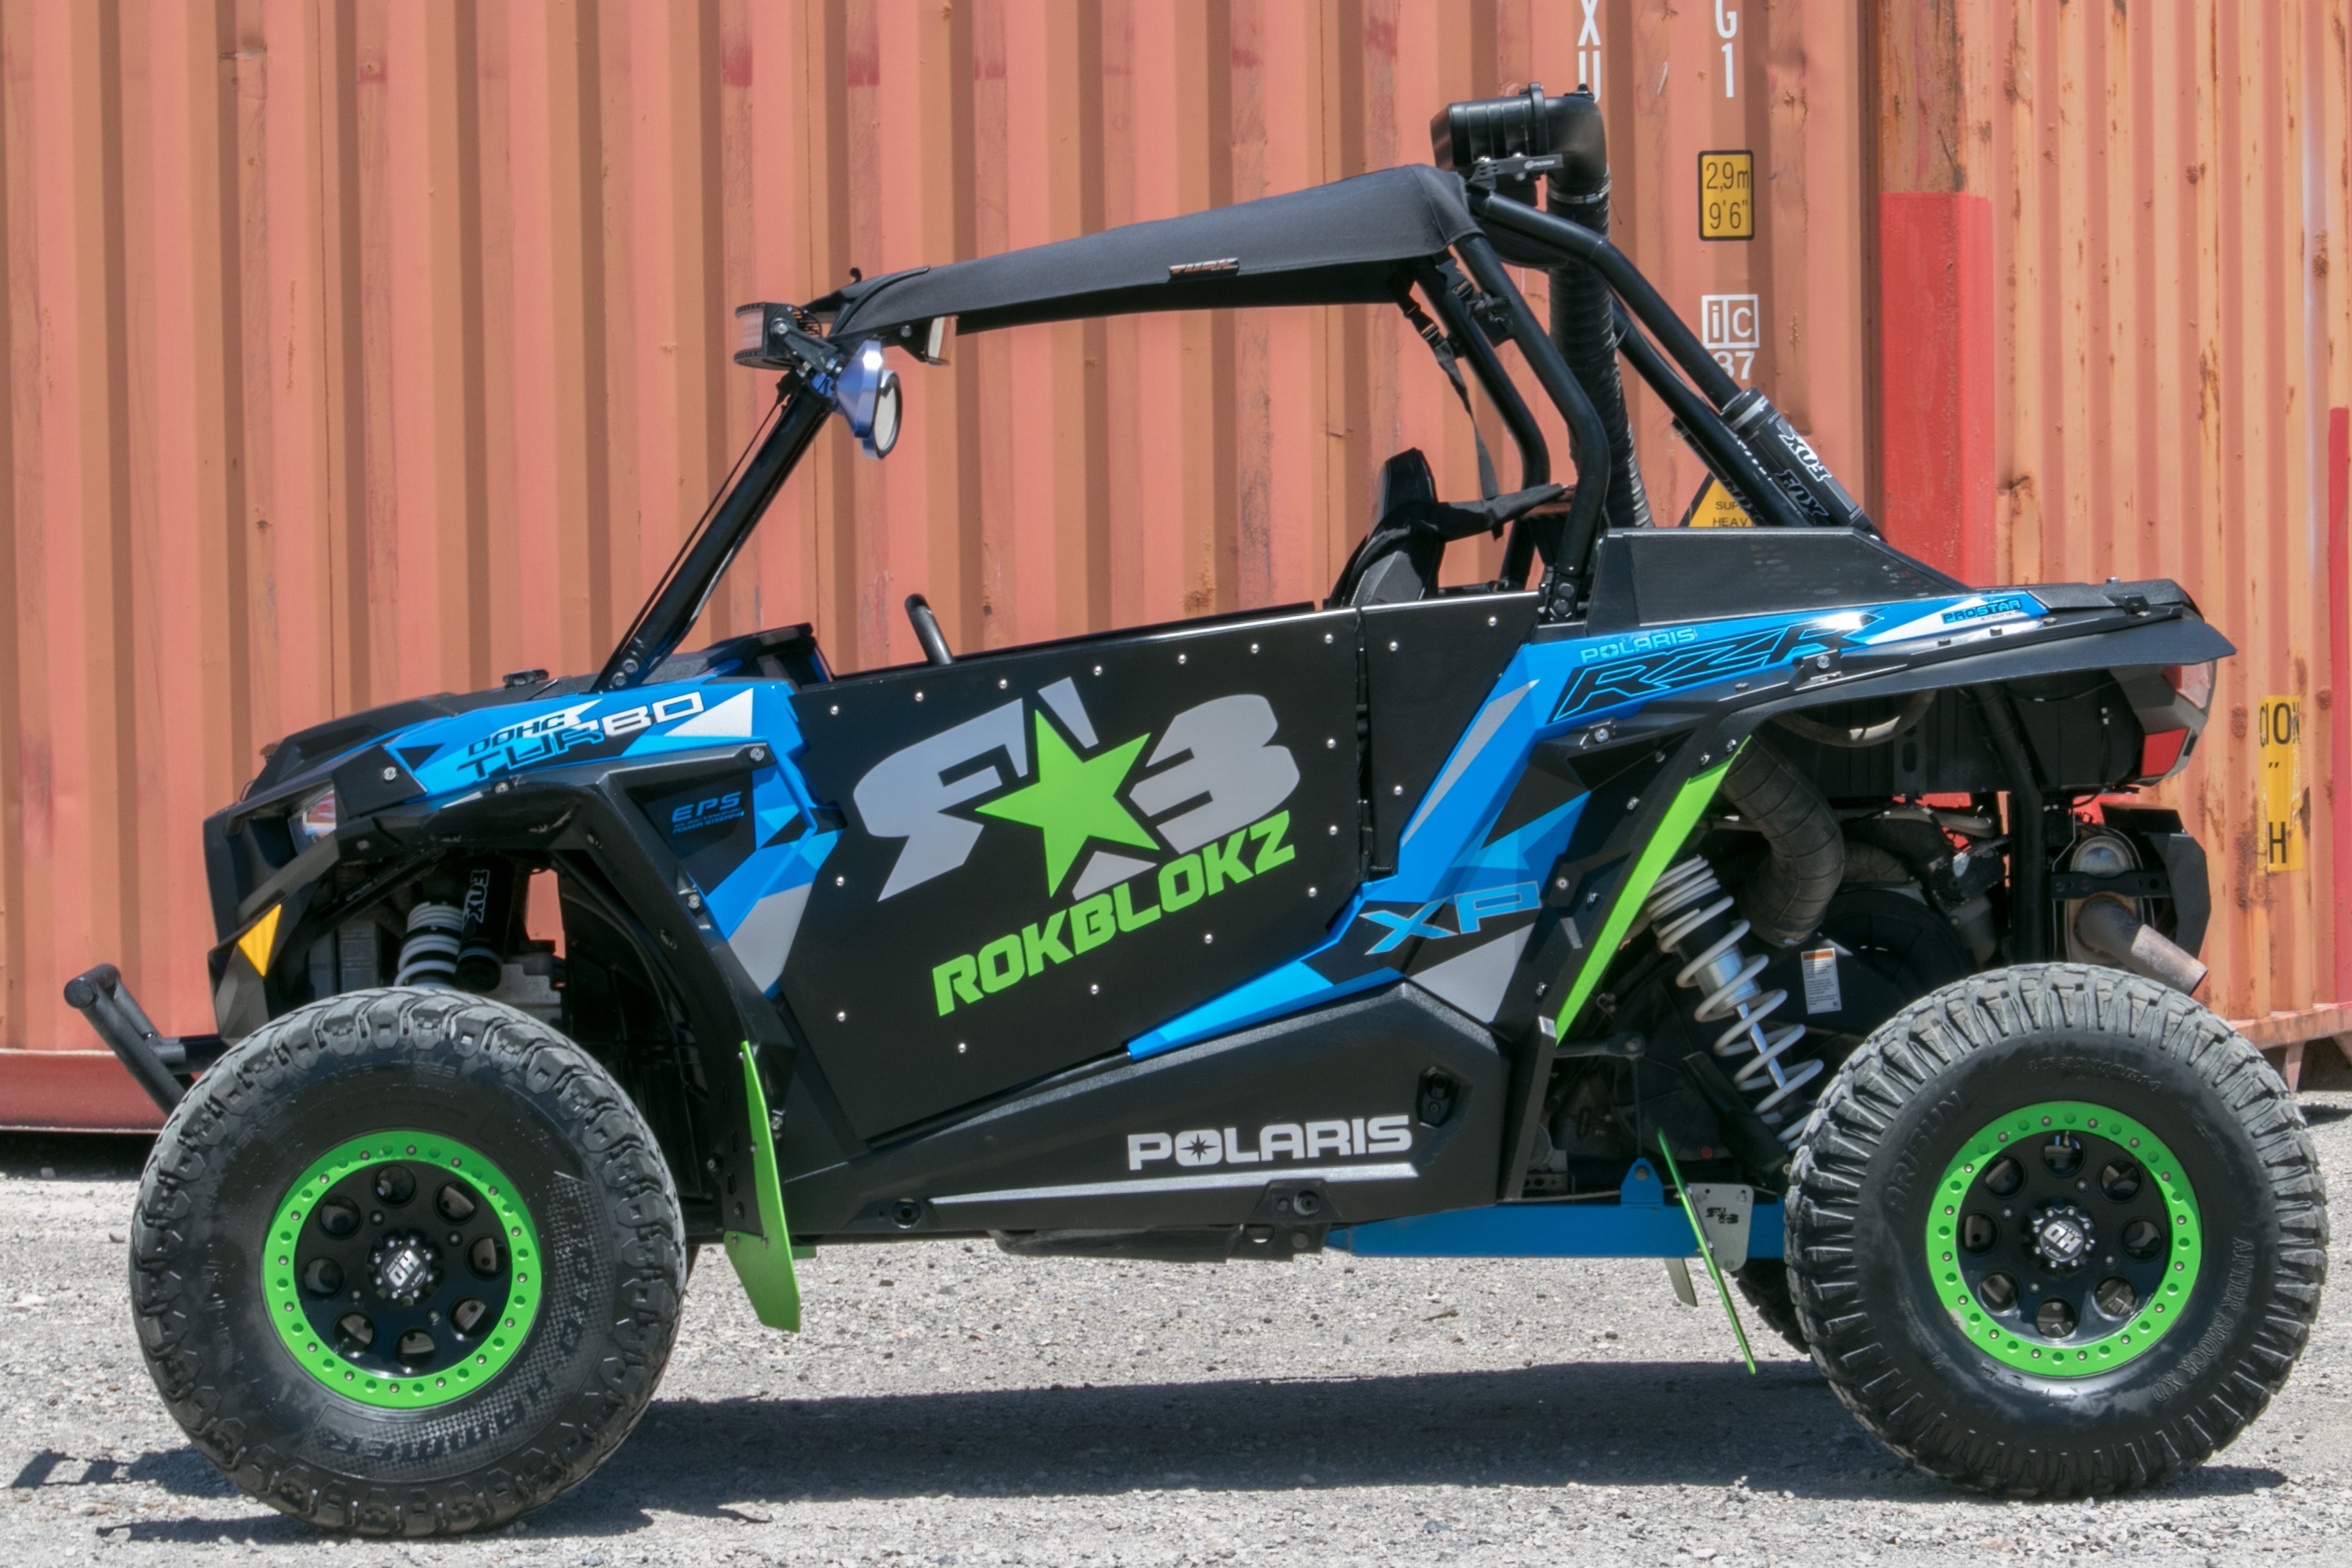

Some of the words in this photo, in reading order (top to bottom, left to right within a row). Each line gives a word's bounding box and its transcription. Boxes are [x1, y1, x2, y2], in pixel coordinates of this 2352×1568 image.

[1778, 424, 1832, 482] FOX
[1712, 517, 1748, 527] HEAV
[1715, 501, 1743, 510] SUP
[1774, 468, 1831, 524] FOX
[1942, 598, 2022, 624] PROSTAR
[1580, 627, 1697, 663] POLARIS
[456, 691, 705, 782] TURBO
[468, 713, 567, 757] DOHC
[671, 791, 742, 823] EPS
[463, 869, 490, 930] FOX
[932, 809, 1296, 1017] ROKBLOKZ
[1358, 880, 1542, 956] XP
[1127, 1114, 1412, 1171] POLARIS
[2219, 1237, 2255, 1314] AFTER
[2176, 1311, 2237, 1382] SHOCK
